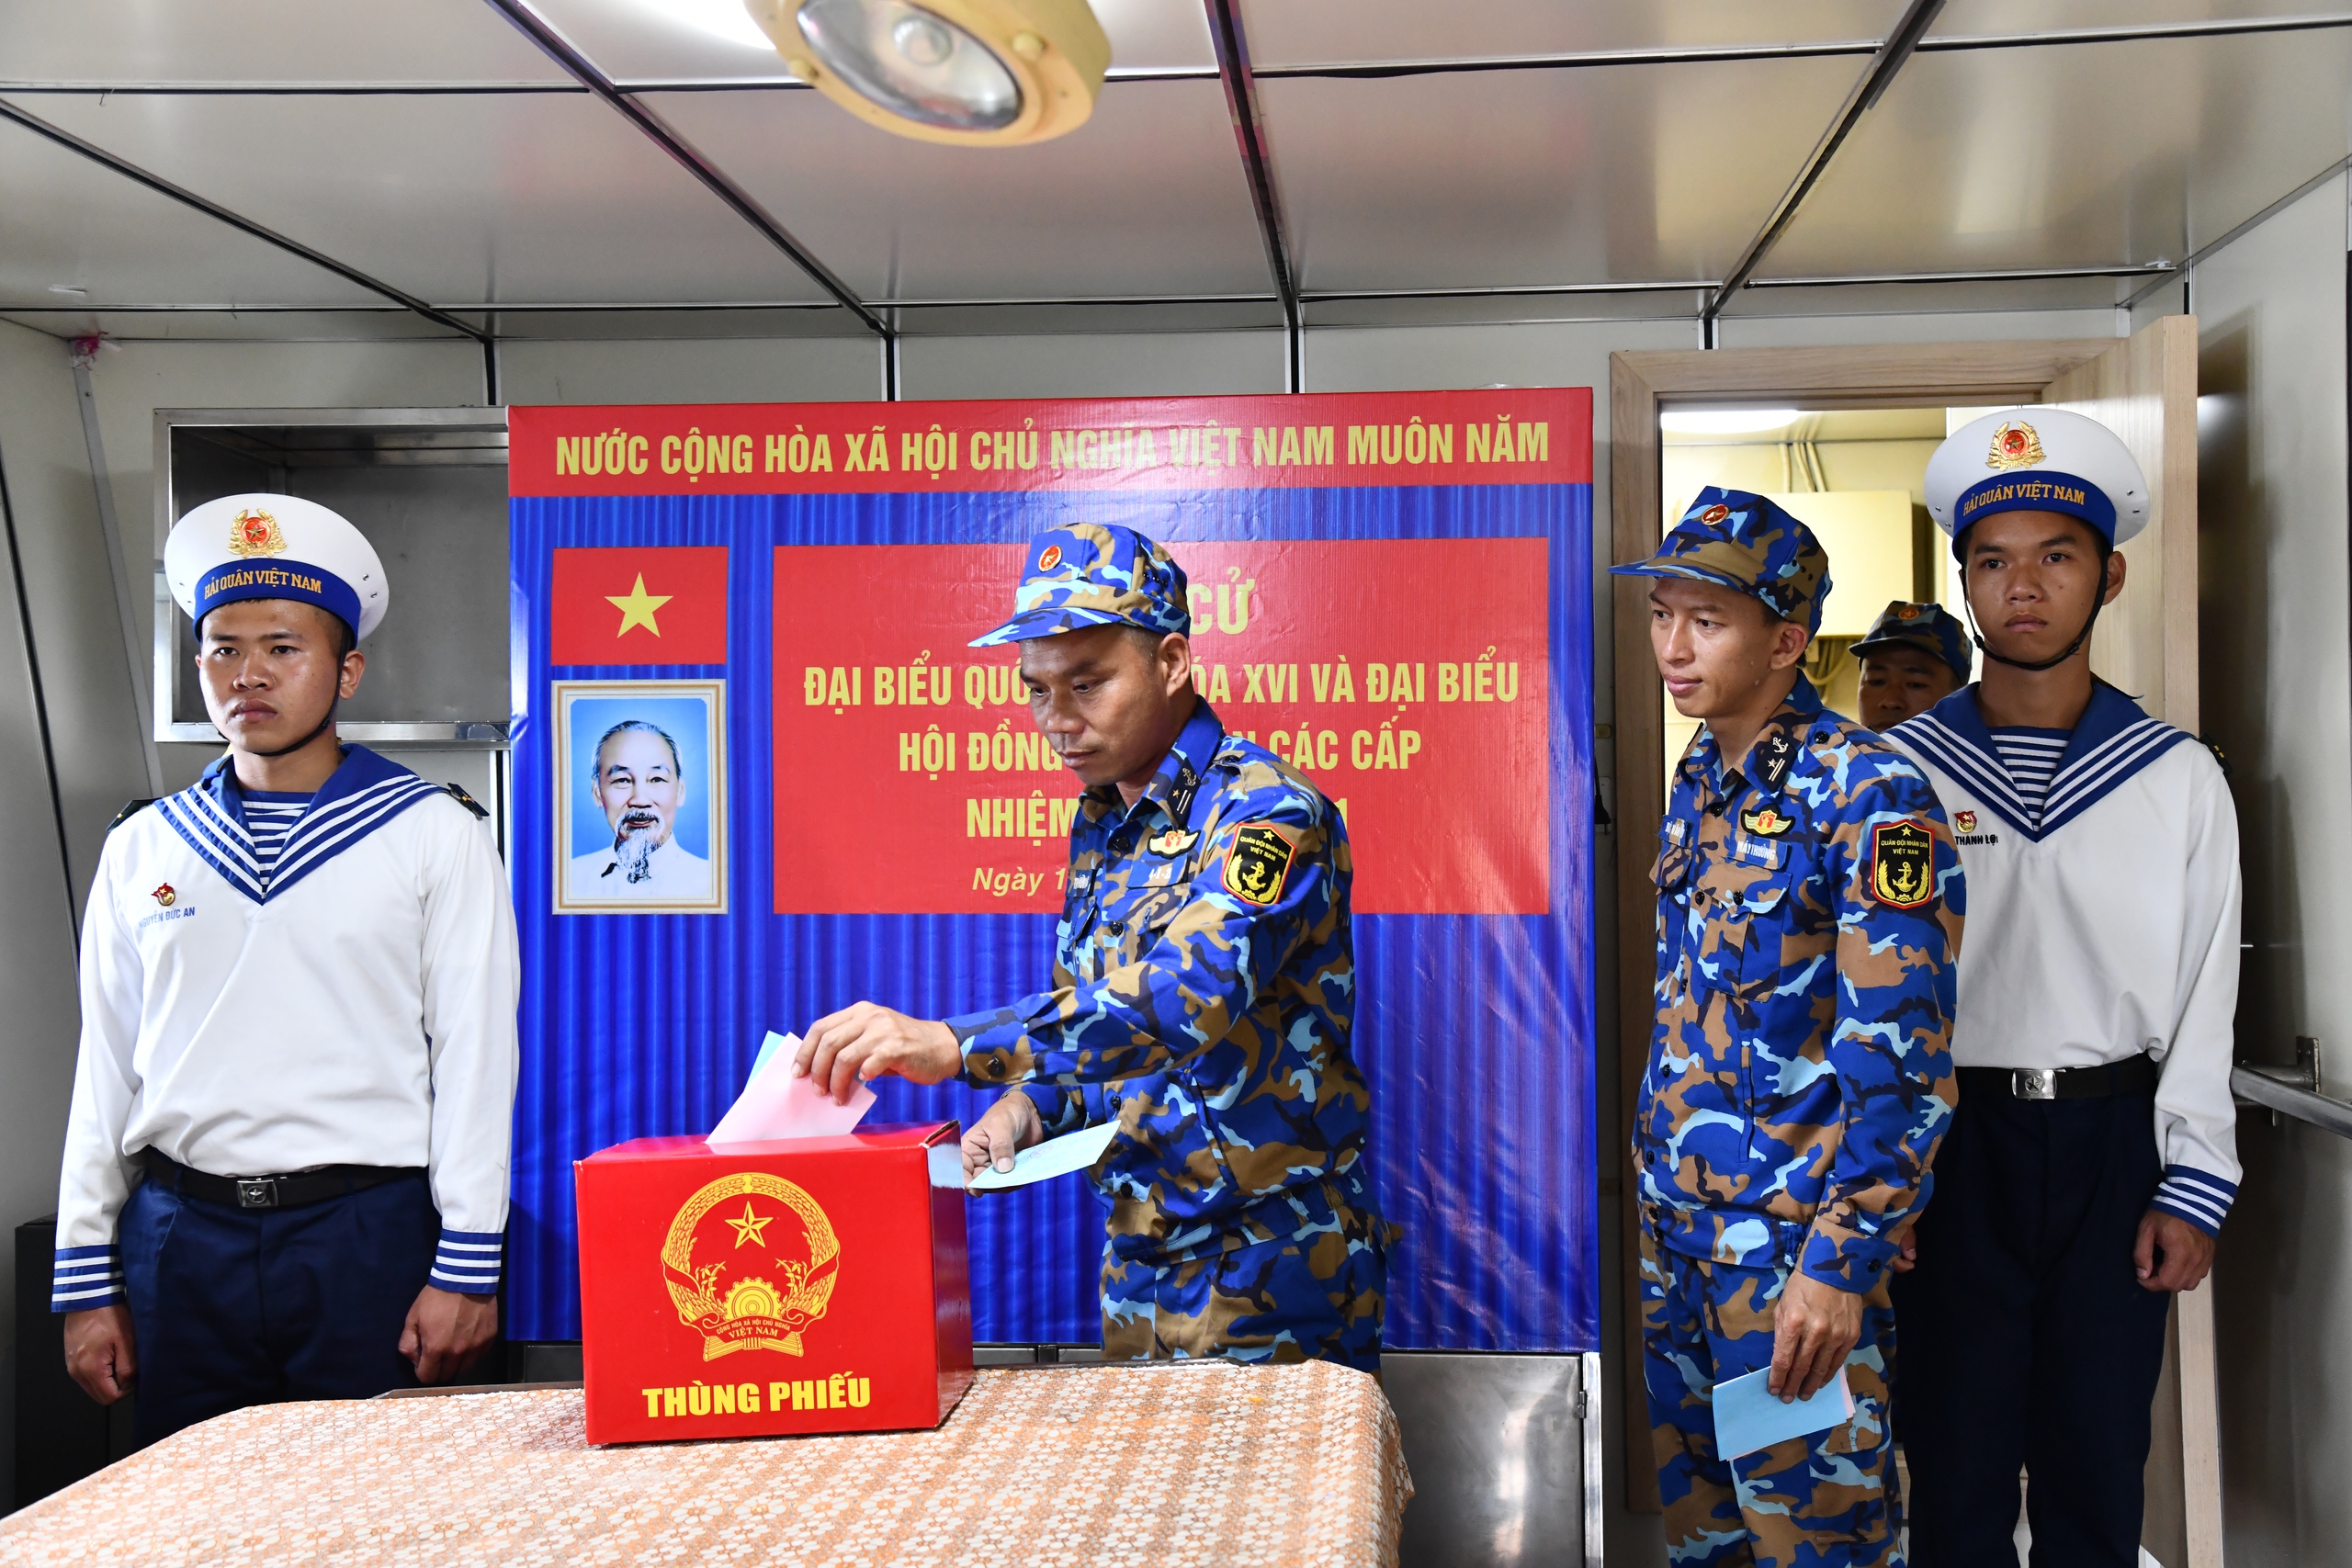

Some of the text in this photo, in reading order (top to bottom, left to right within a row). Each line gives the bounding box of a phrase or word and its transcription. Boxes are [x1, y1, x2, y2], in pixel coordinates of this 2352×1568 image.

[557, 414, 1549, 483] NƯỚC CỘNG HÒA XÃ HỘI CHỦ NGHĨA VIỆT NAM MUÔN NĂM
[1962, 479, 2085, 517] HẢI QUÂN VIỆT NAM
[204, 568, 322, 601] HẢI QUÂN VIỆT NAM
[1186, 566, 1256, 636] CỬ
[804, 666, 862, 716] ĐẠI
[874, 649, 952, 706] BIỂU
[1190, 655, 1232, 704] ÓA
[1243, 663, 1298, 704] XVI
[1311, 654, 1356, 703] VÀ
[1365, 662, 1425, 712] ĐẠI
[1439, 645, 1519, 703] BIỂU
[899, 723, 956, 781] HỘI
[967, 717, 1063, 772] ĐỒNG
[1269, 721, 1339, 770] CÁC
[1351, 715, 1421, 770] CẤP
[967, 789, 1080, 847] NHIỆM
[1263, 852, 1276, 862] NAM
[972, 867, 1044, 897] Ngày
[1055, 867, 1066, 891] 1
[183, 907, 196, 918] AN
[729, 1326, 778, 1338] VIỆT NAM
[641, 1371, 871, 1418] THÙNG PHIẾU
